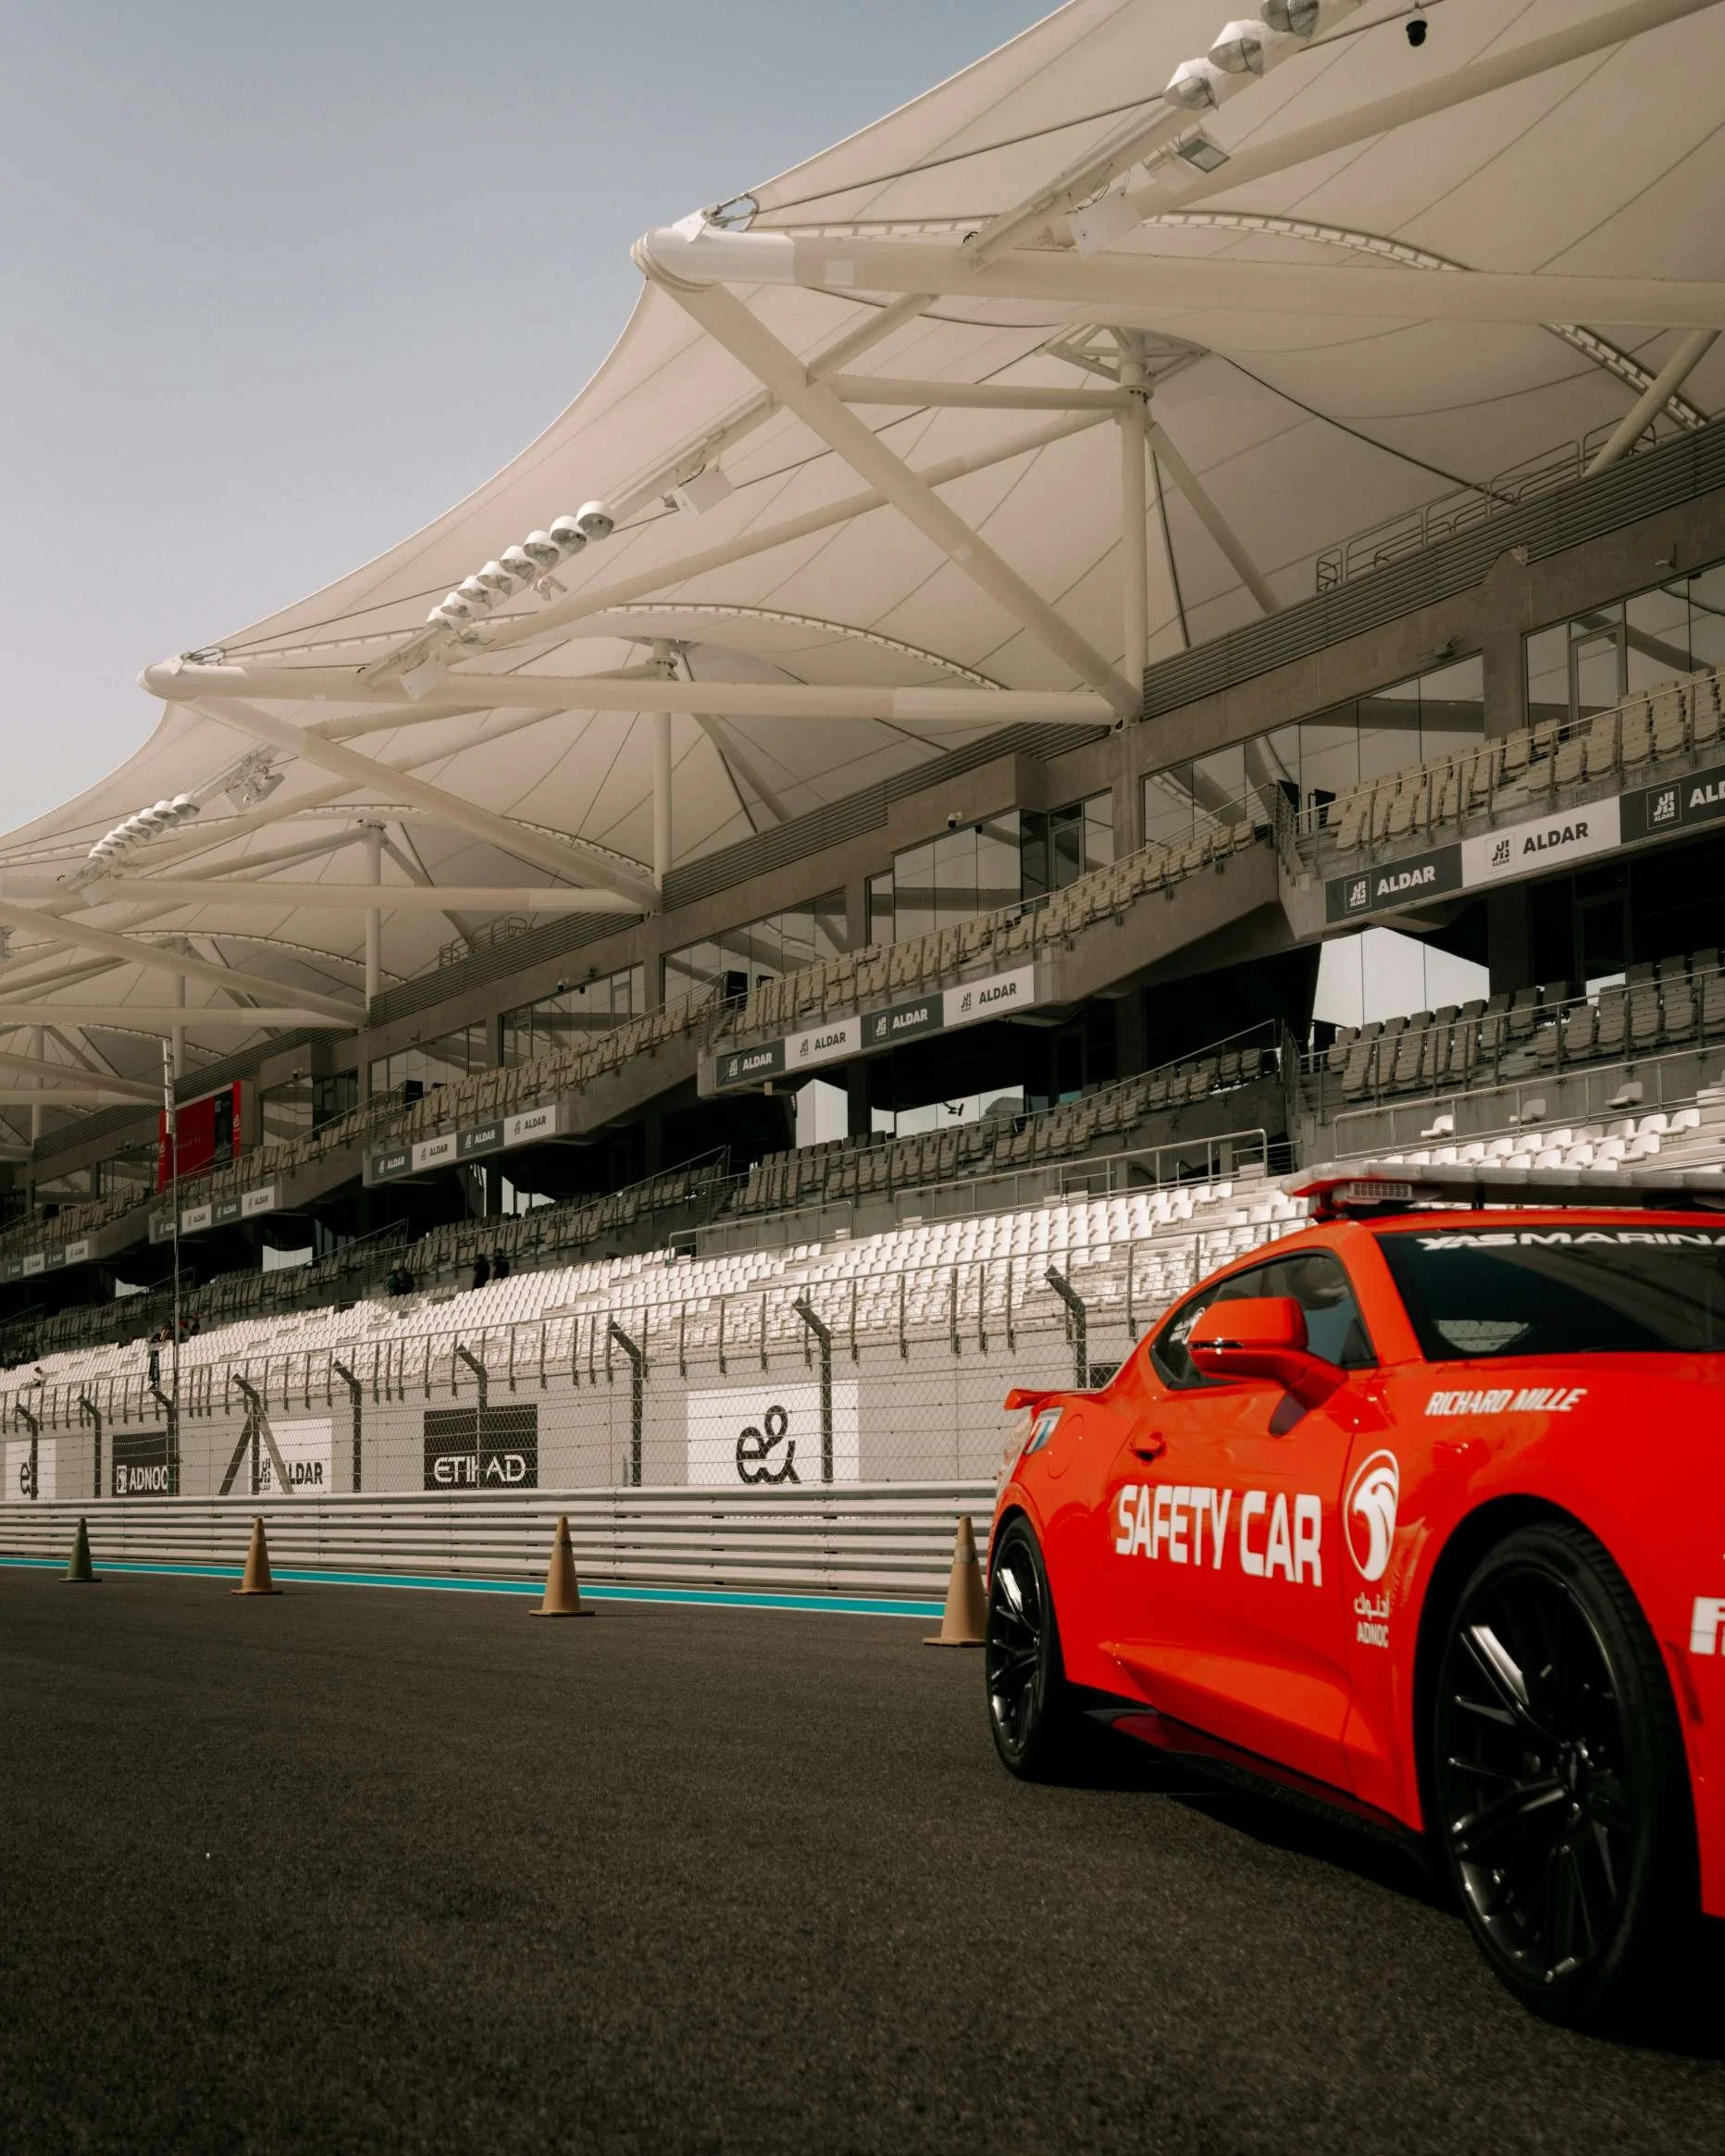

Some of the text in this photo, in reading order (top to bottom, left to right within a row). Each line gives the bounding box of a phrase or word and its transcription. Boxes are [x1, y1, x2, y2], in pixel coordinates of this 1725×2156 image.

[1522, 822, 1589, 854] ALDAR
[1376, 865, 1436, 896] ALDAR
[978, 982, 1017, 1005] ALDAR
[892, 1009, 928, 1029] ALDAR
[814, 1032, 846, 1050] ALDAR
[742, 1052, 773, 1071] ALDAR
[524, 1115, 547, 1129] ALDAR
[474, 1129, 496, 1144] ALDAR
[429, 1143, 449, 1157] ALDAR
[387, 1156, 405, 1170] ALDAR
[1416, 1232, 1725, 1251] YAS MARIN
[1426, 1388, 1587, 1416] RICHARD MILLE
[279, 1461, 324, 1485] LDAR
[1115, 1483, 1323, 1588] SAFETY CAR
[1357, 1620, 1389, 1649] ADNOC
